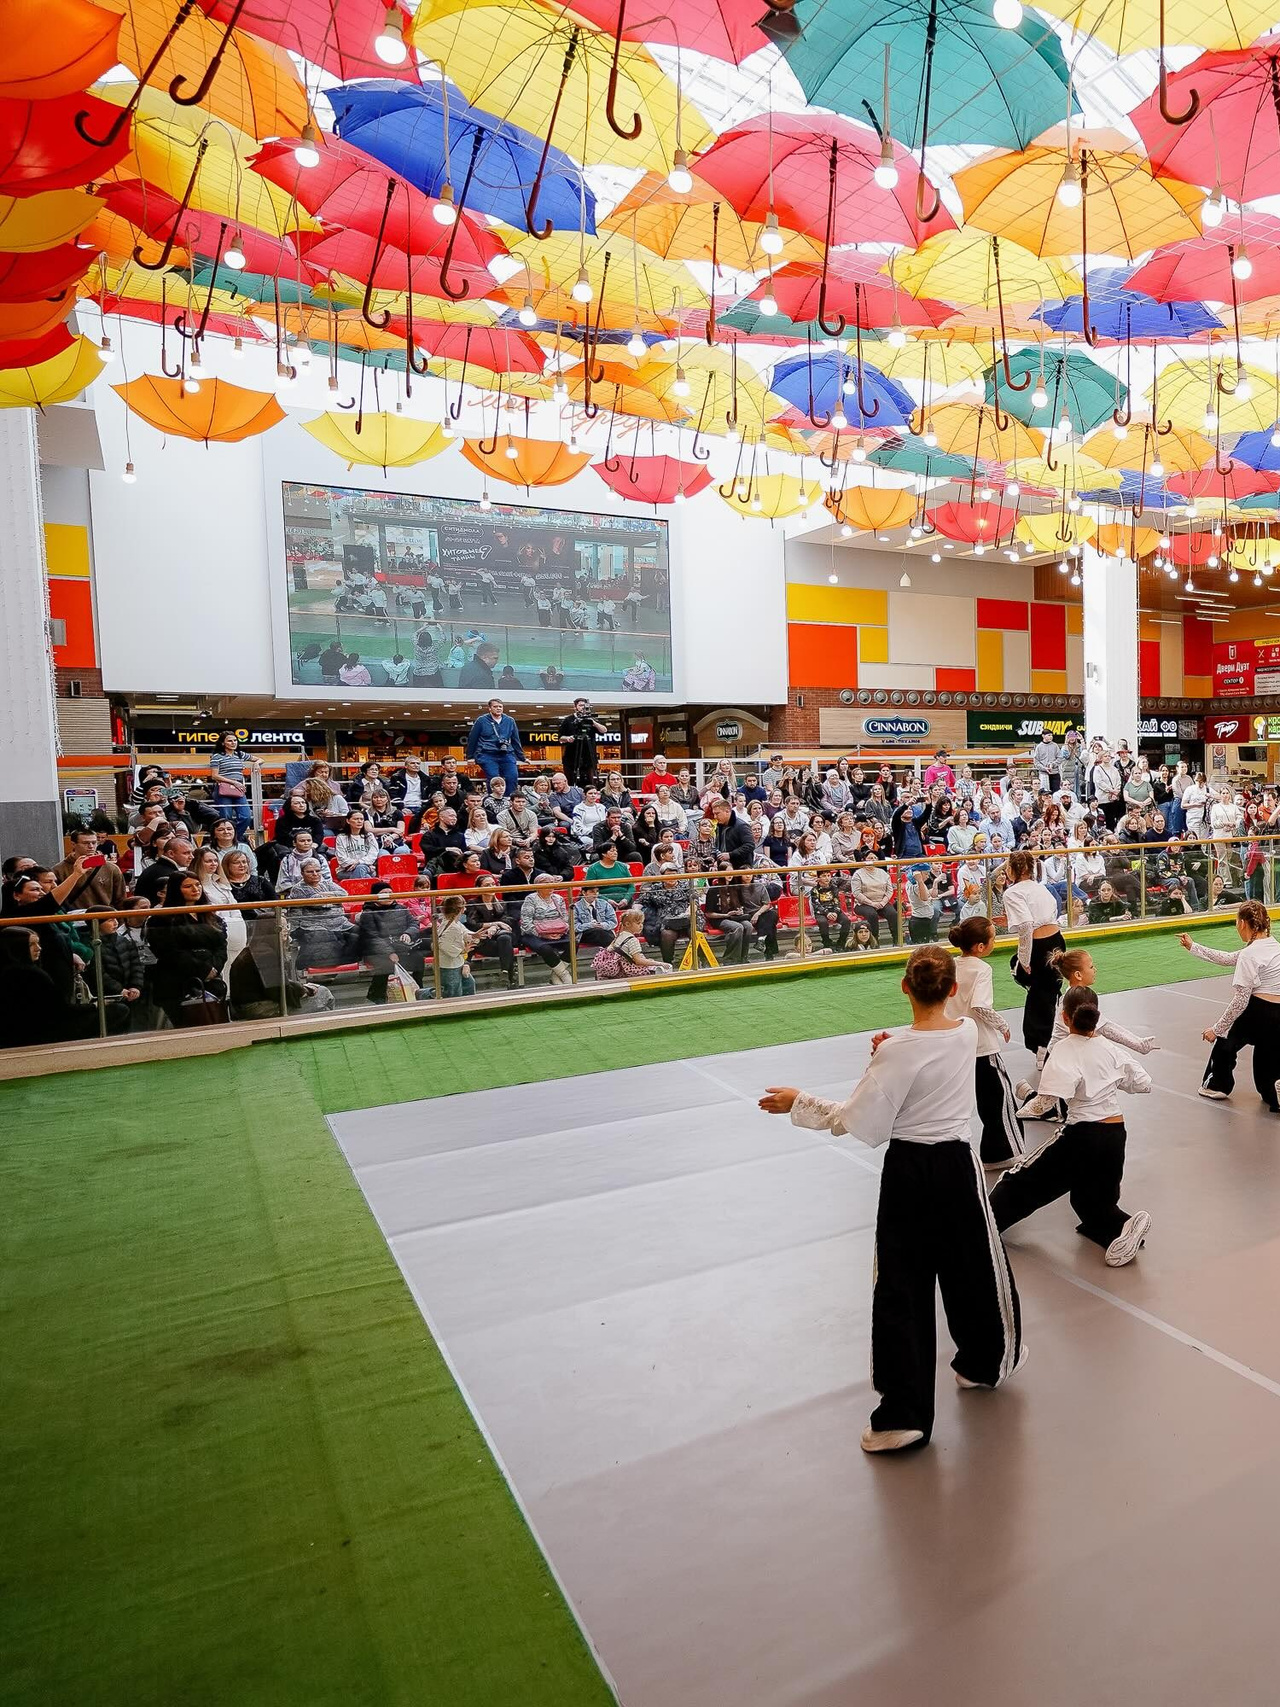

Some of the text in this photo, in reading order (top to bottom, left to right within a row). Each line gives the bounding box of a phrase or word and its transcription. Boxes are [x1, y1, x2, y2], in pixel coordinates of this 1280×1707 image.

[1216, 663, 1235, 675] Двери
[1235, 661, 1250, 673] Дуэт
[869, 721, 926, 732] CINNABON
[1016, 720, 1073, 736] SUBWAY
[178, 732, 305, 742] гипе лента
